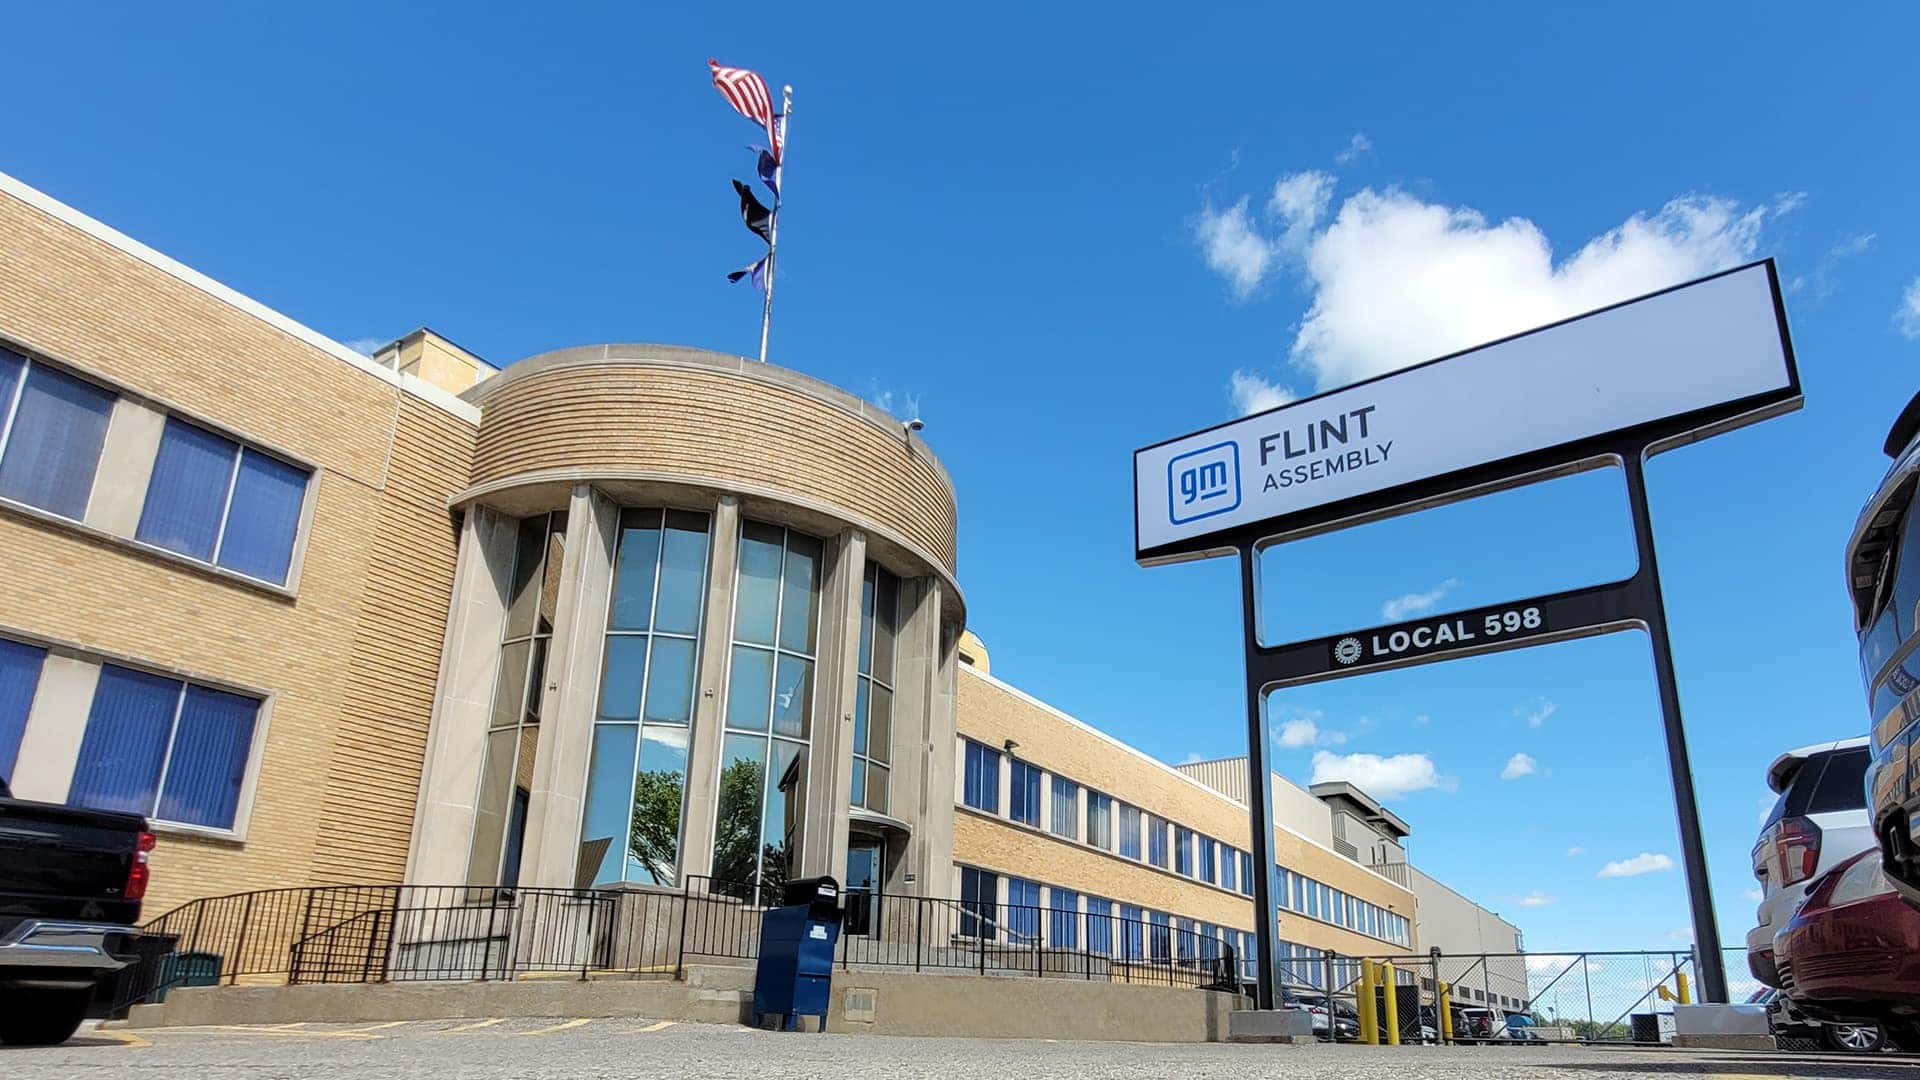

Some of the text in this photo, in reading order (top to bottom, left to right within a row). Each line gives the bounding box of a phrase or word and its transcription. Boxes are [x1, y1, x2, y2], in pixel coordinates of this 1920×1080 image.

[1259, 405, 1375, 466] FLINT
[1180, 460, 1227, 505] gm
[1263, 440, 1393, 493] ASSEMBLY
[1372, 607, 1542, 656] LOCAL 598
